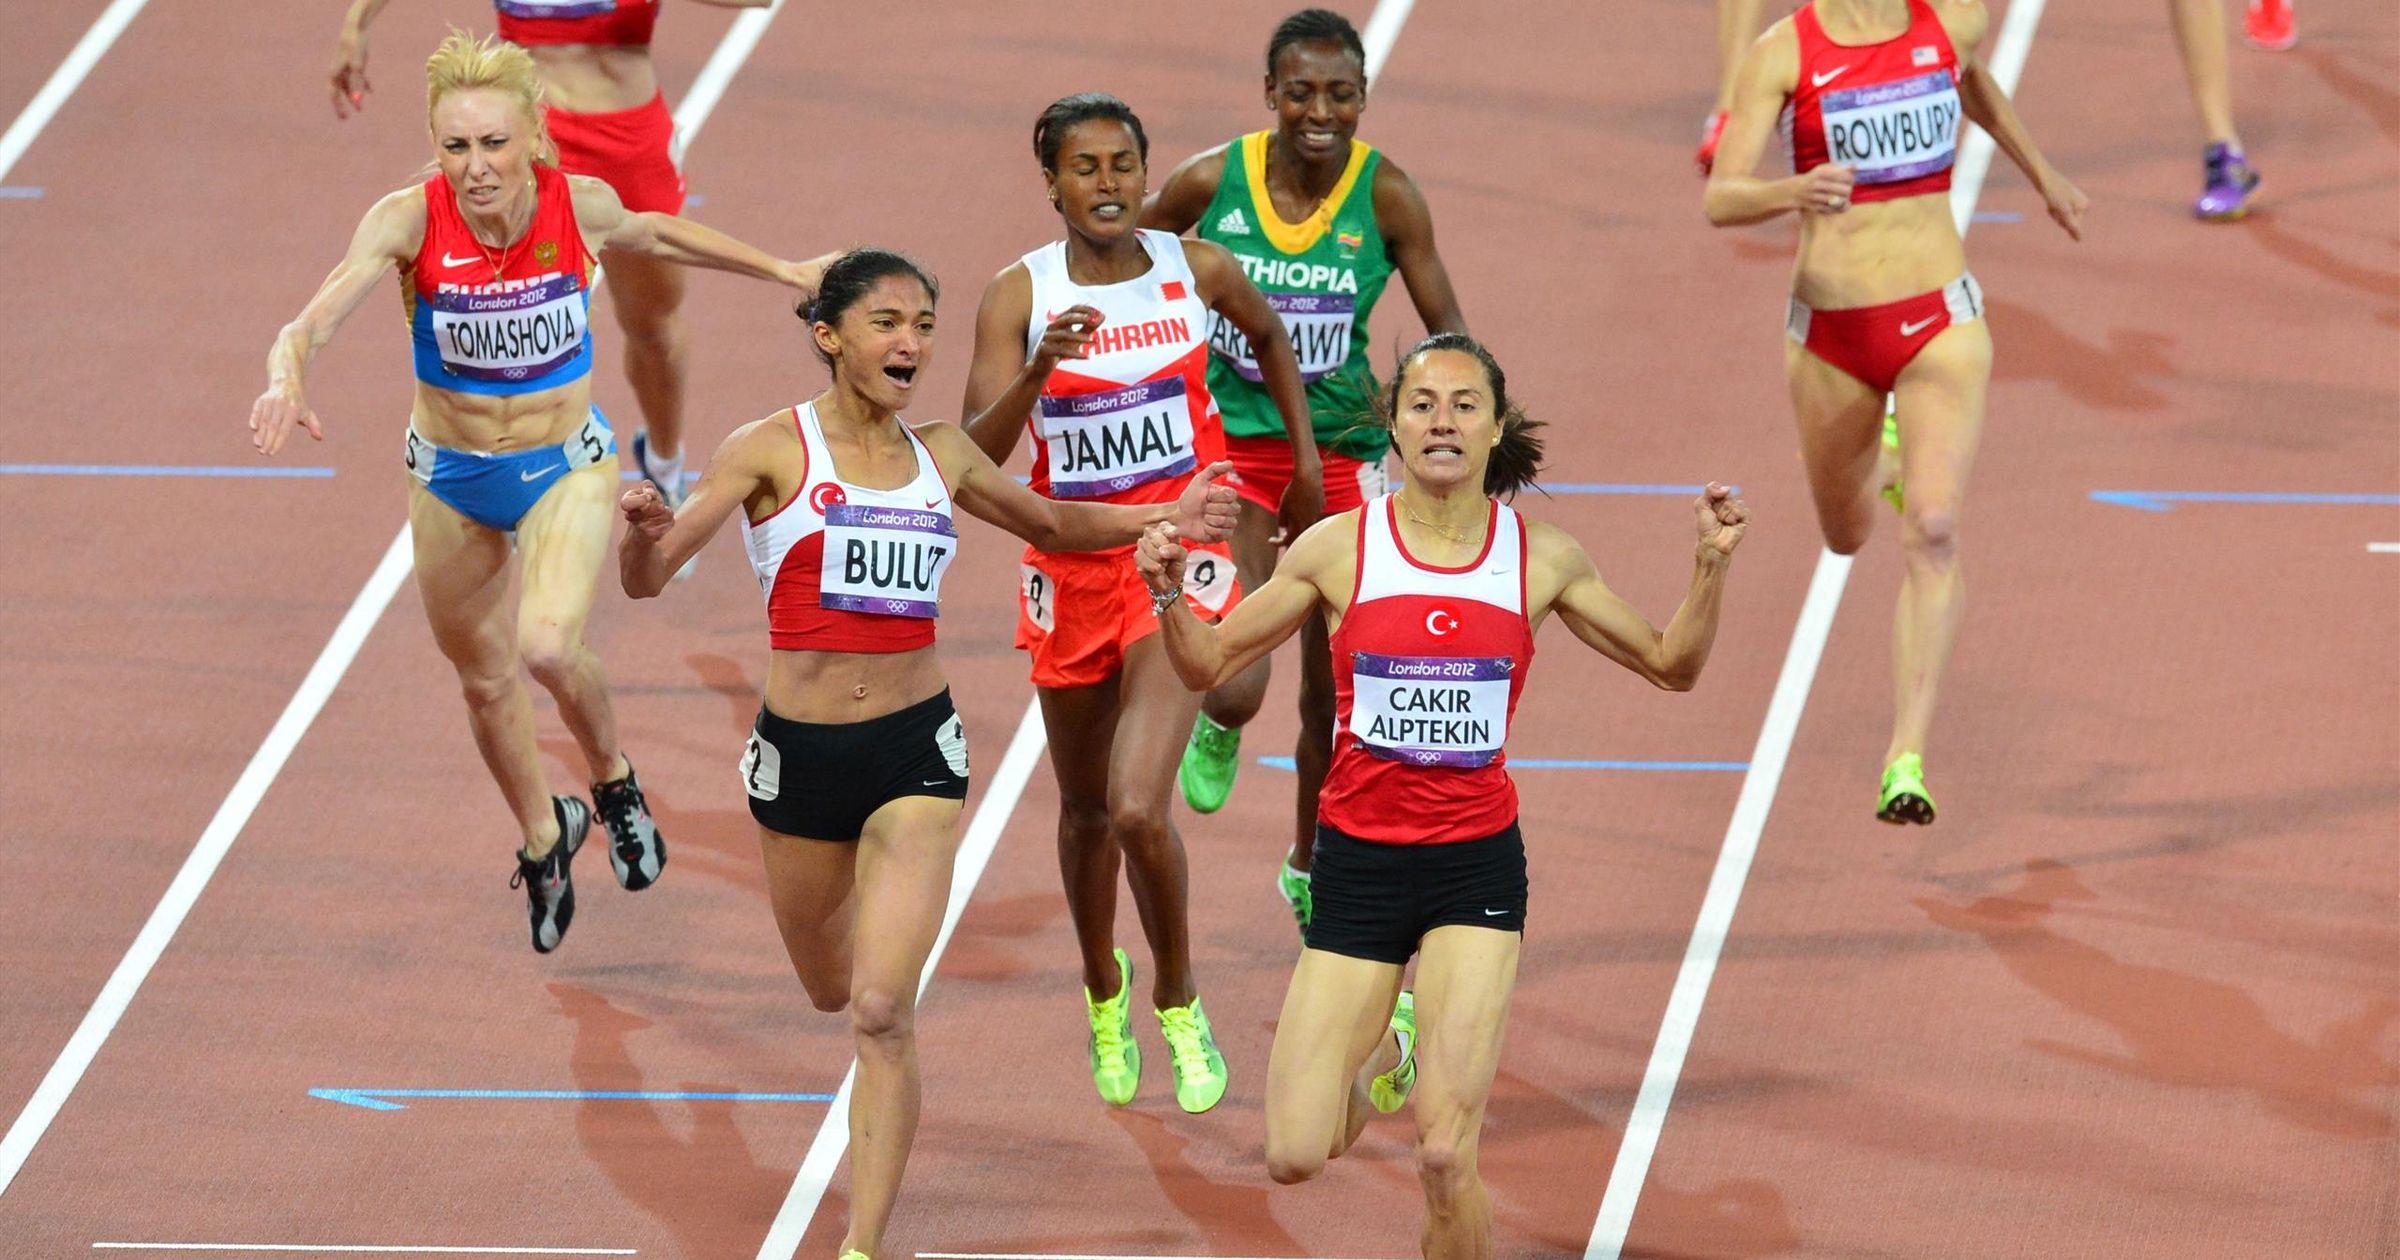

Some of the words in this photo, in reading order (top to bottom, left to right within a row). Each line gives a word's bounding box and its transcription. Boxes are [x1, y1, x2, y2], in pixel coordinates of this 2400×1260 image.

[1832, 100, 1956, 160] ROWBURY
[1233, 253, 1358, 294] THIOPIA
[468, 297, 517, 310] London
[519, 287, 547, 305] 2012
[1289, 297, 1320, 311] 2012
[446, 305, 576, 360] TOMASHOVA
[1072, 317, 1190, 360] AHRAIN
[1071, 397, 1118, 413] London
[1120, 387, 1149, 405] 2012
[406, 429, 419, 470] 5
[581, 422, 604, 463] 5
[1061, 411, 1184, 473] JAMAL
[863, 508, 910, 526] London
[912, 514, 938, 529] 2012
[844, 538, 947, 592] BULUT
[1193, 559, 1216, 591] 9
[1030, 573, 1043, 620] 9
[1388, 661, 1440, 676] London
[1443, 662, 1476, 677] 2012
[1389, 687, 1472, 713] CAKIR
[1367, 714, 1489, 744] ALPTEKIN
[749, 739, 762, 791] 2
